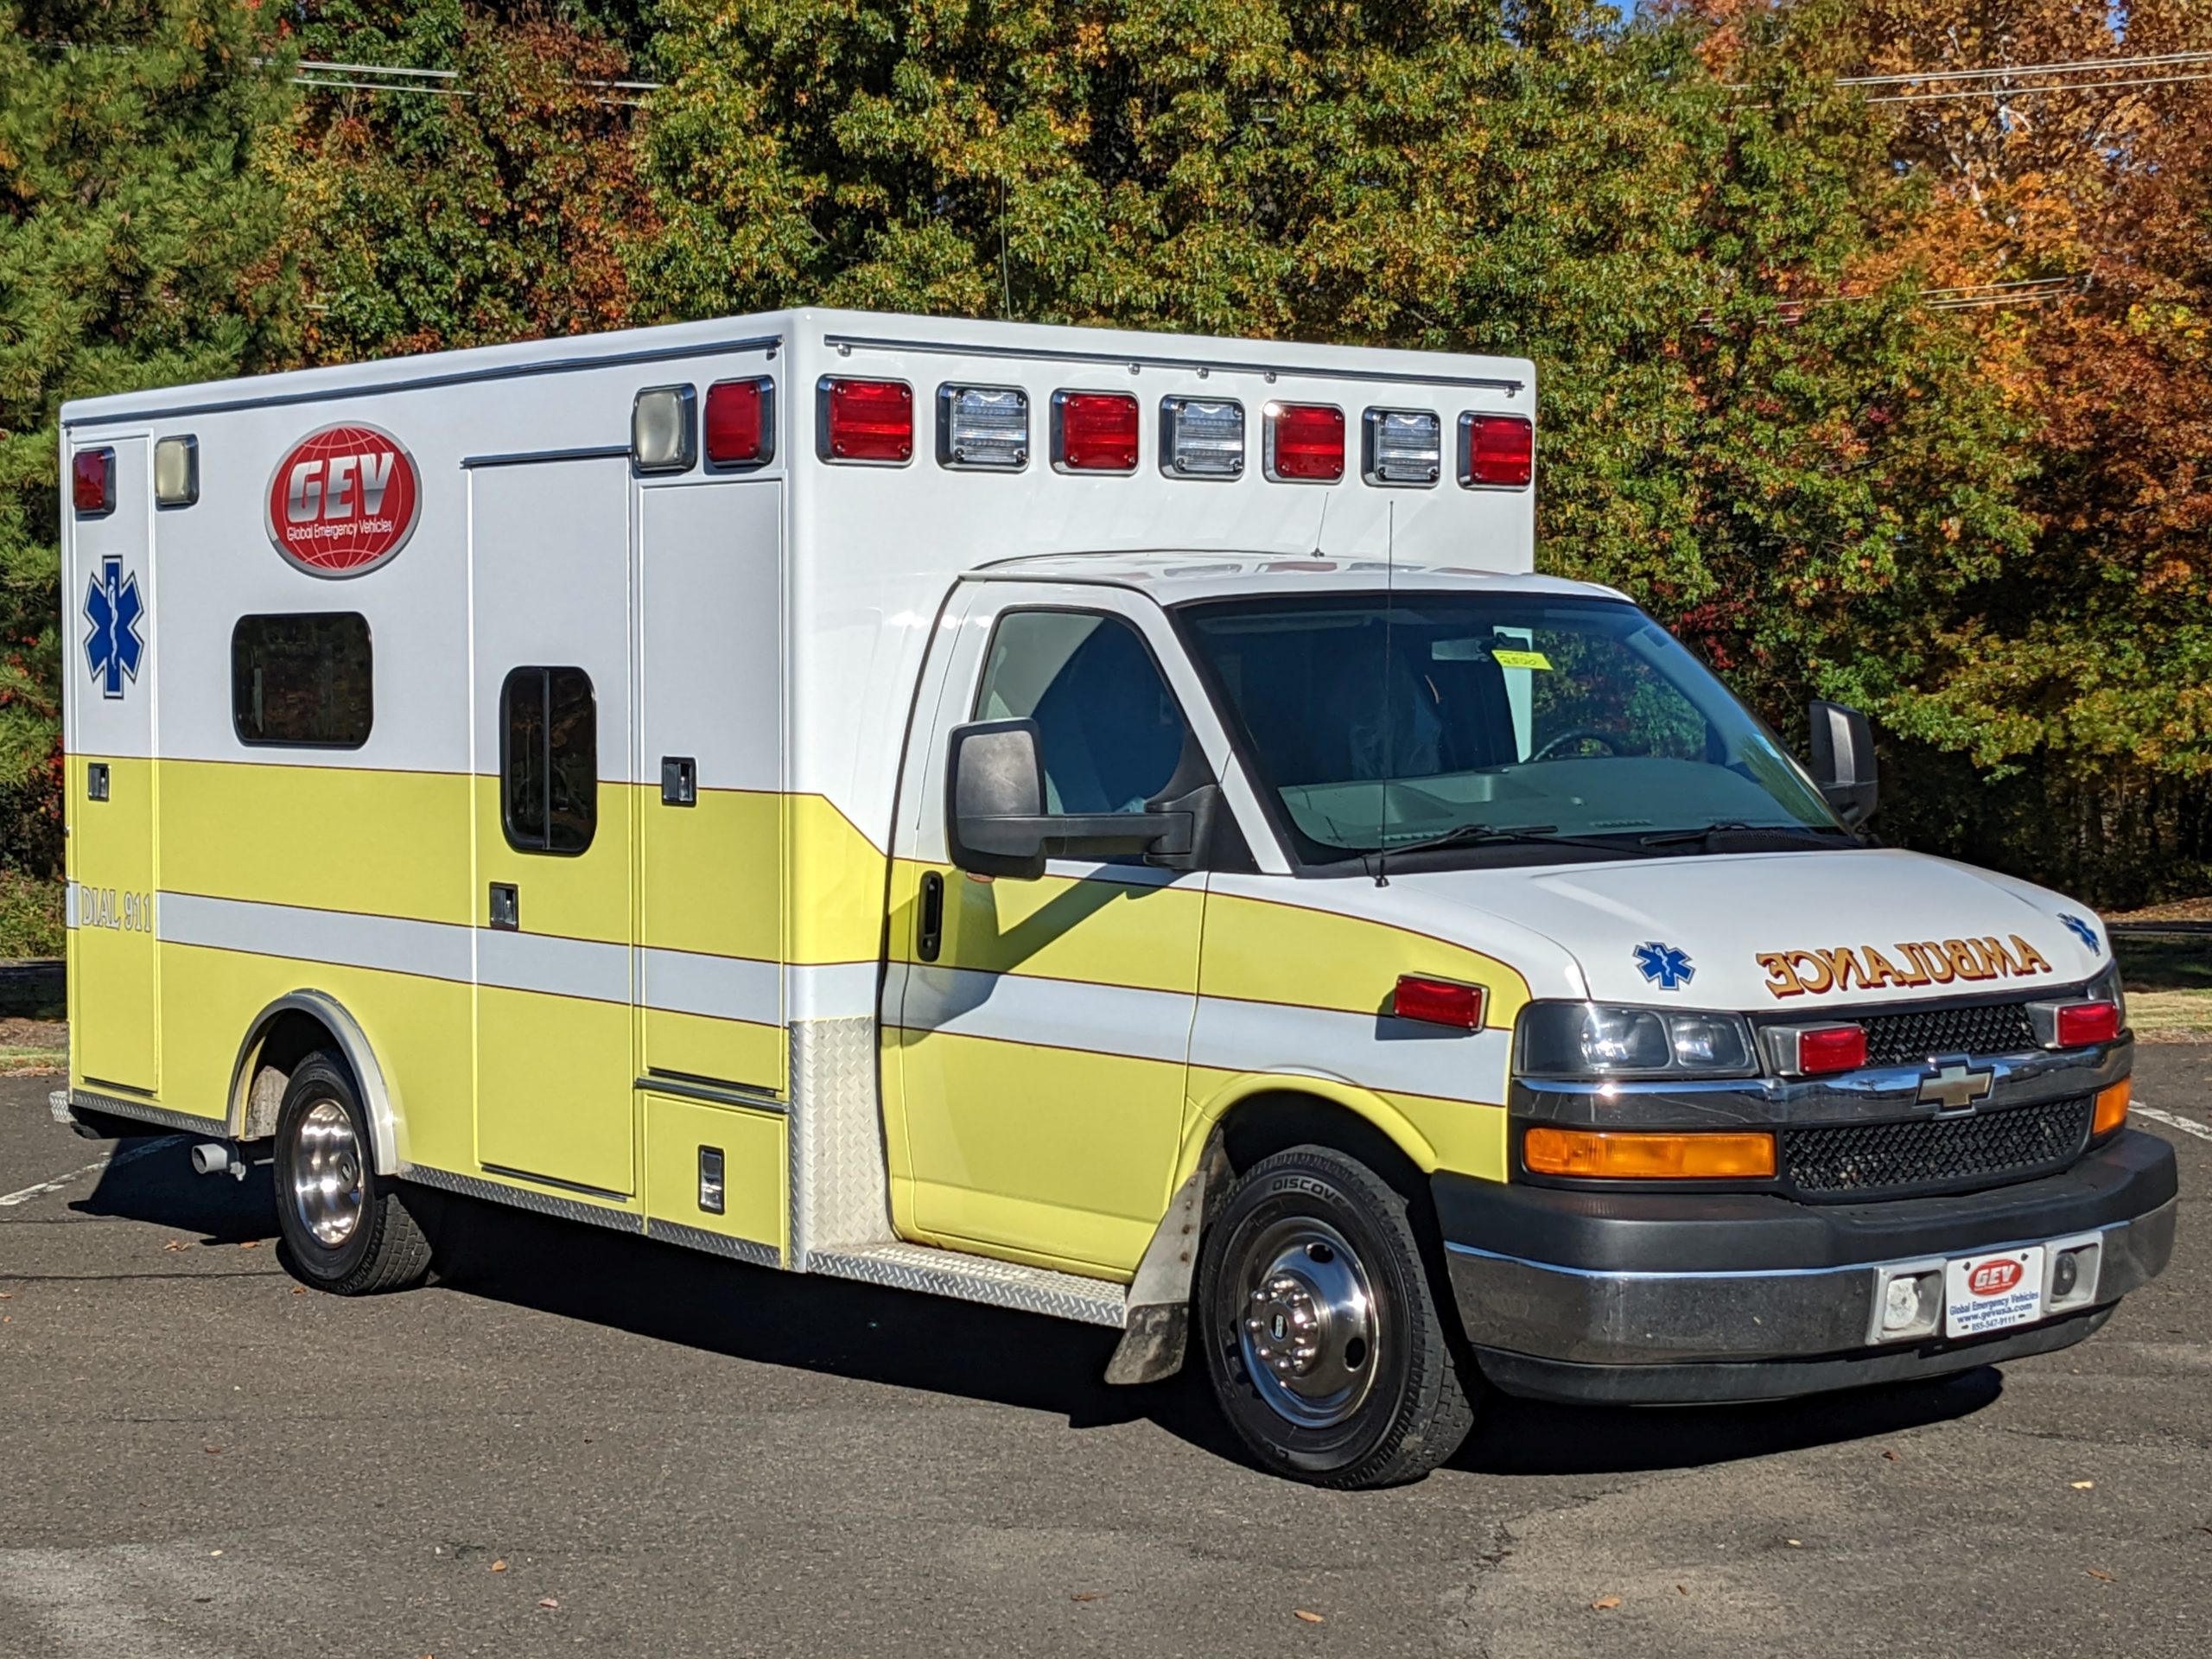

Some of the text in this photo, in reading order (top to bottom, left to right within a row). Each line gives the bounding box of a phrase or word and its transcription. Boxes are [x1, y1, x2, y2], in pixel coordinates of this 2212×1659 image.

[288, 452, 394, 523] GEV
[287, 519, 391, 541] Global Emergency Vehicles
[81, 886, 151, 933] DIAL 911
[1974, 1264, 2016, 1287] GEV
[1949, 1292, 2038, 1315] Global Emergency Vehicles
[1957, 1303, 2032, 1324] www.gevusa.com
